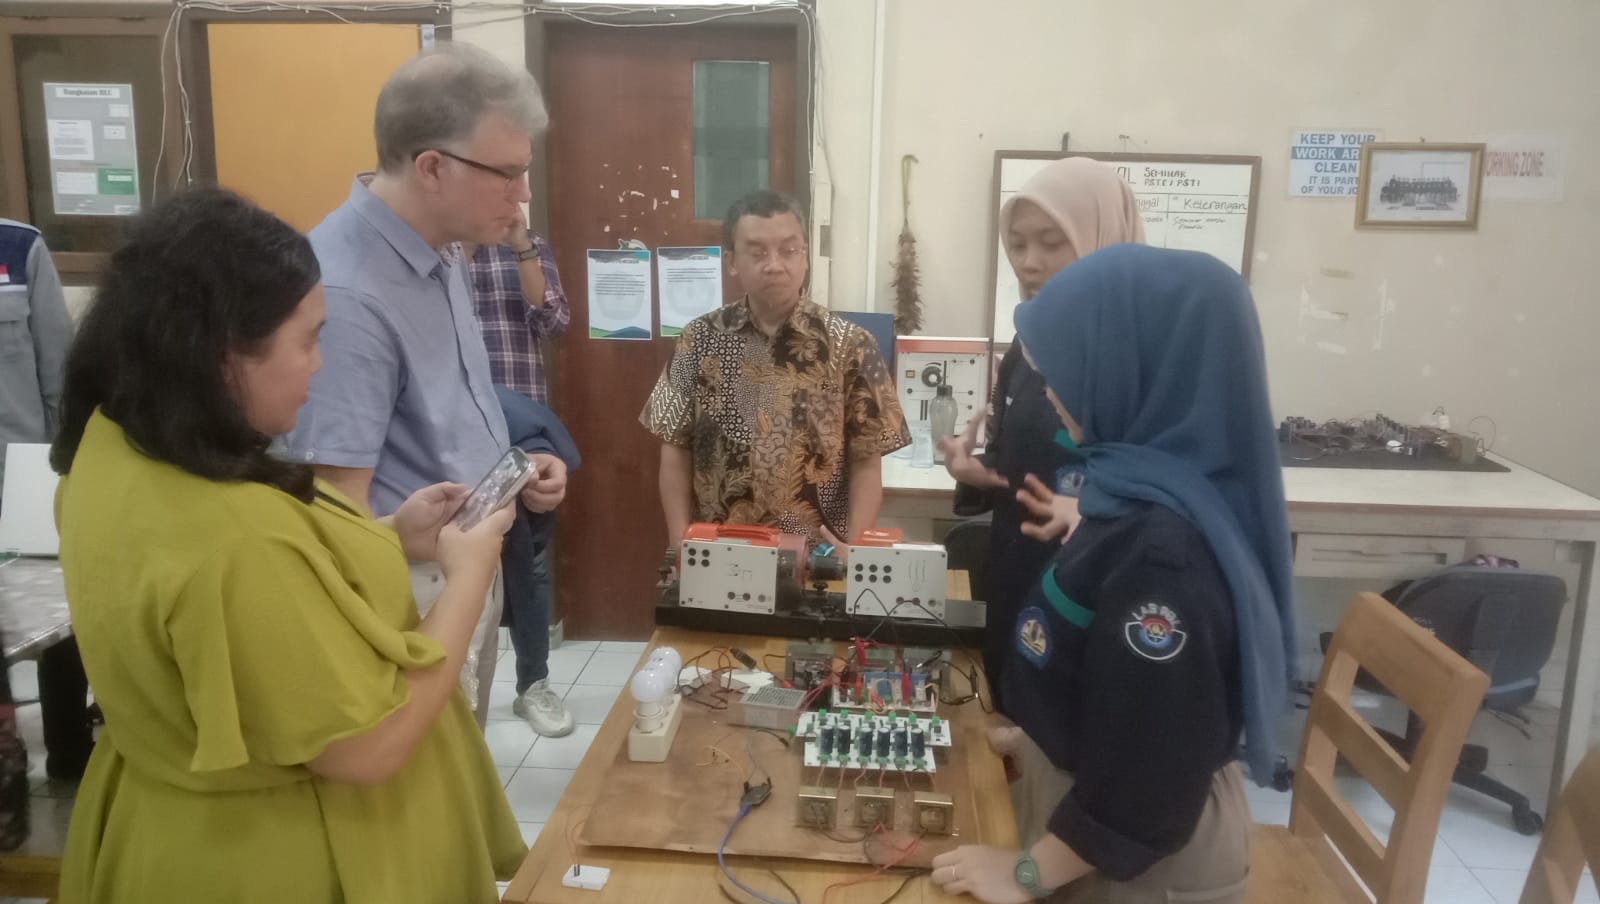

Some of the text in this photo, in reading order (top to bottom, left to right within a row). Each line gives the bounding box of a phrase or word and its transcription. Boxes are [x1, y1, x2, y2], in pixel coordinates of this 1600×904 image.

[1300, 133, 1376, 145] KEEP YOUR
[1295, 147, 1360, 159] WORK AR
[1314, 162, 1358, 173] CLEAN
[1484, 151, 1519, 177] ORKING
[1309, 175, 1318, 185] IT
[1321, 176, 1330, 185] IS
[1300, 185, 1360, 196] OF YOUR JO
